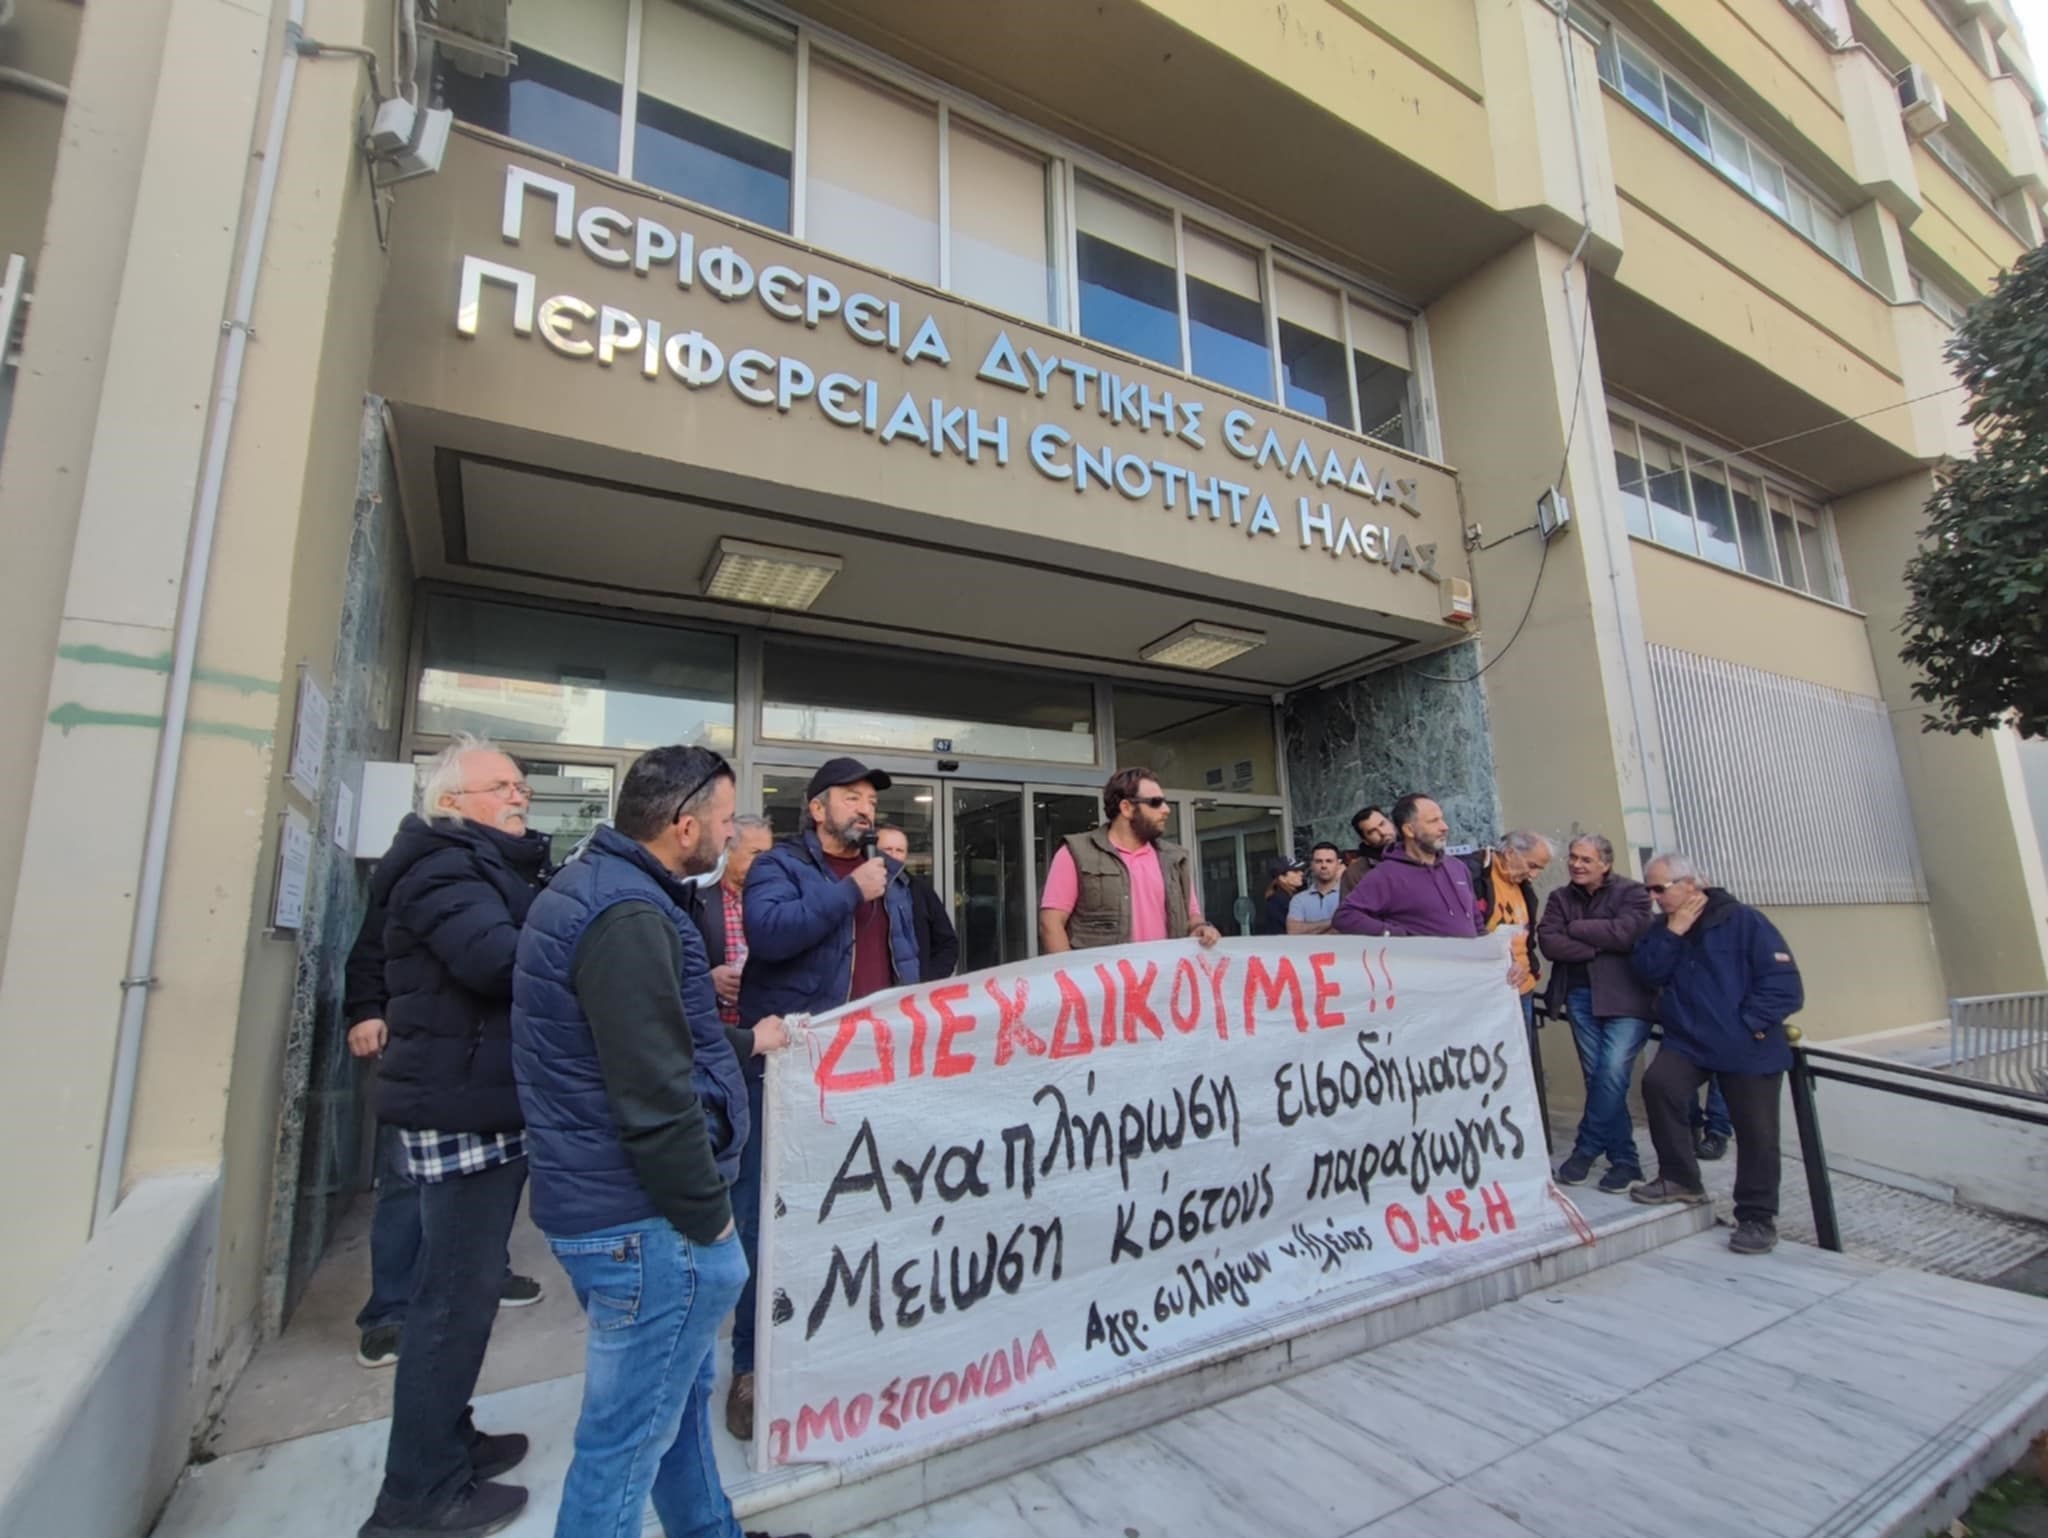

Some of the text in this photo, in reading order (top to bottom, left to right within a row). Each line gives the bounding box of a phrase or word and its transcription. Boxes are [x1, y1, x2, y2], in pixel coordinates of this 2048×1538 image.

[456, 255, 1441, 584] ΠΕΡΙΦΕΡΕΙΑΚΗ ΕΝΟΤΗΤΑ ΗΛΕΙΑΣ
[502, 165, 1422, 518] ΠΕΡΙΦΕΡΕΙΑ ΔΥΤΙΚΗΣ ΕΛΛΑΔΑΣ
[805, 1214, 1064, 1342] Μείωση
[1306, 1093, 1525, 1204] παραγωγής
